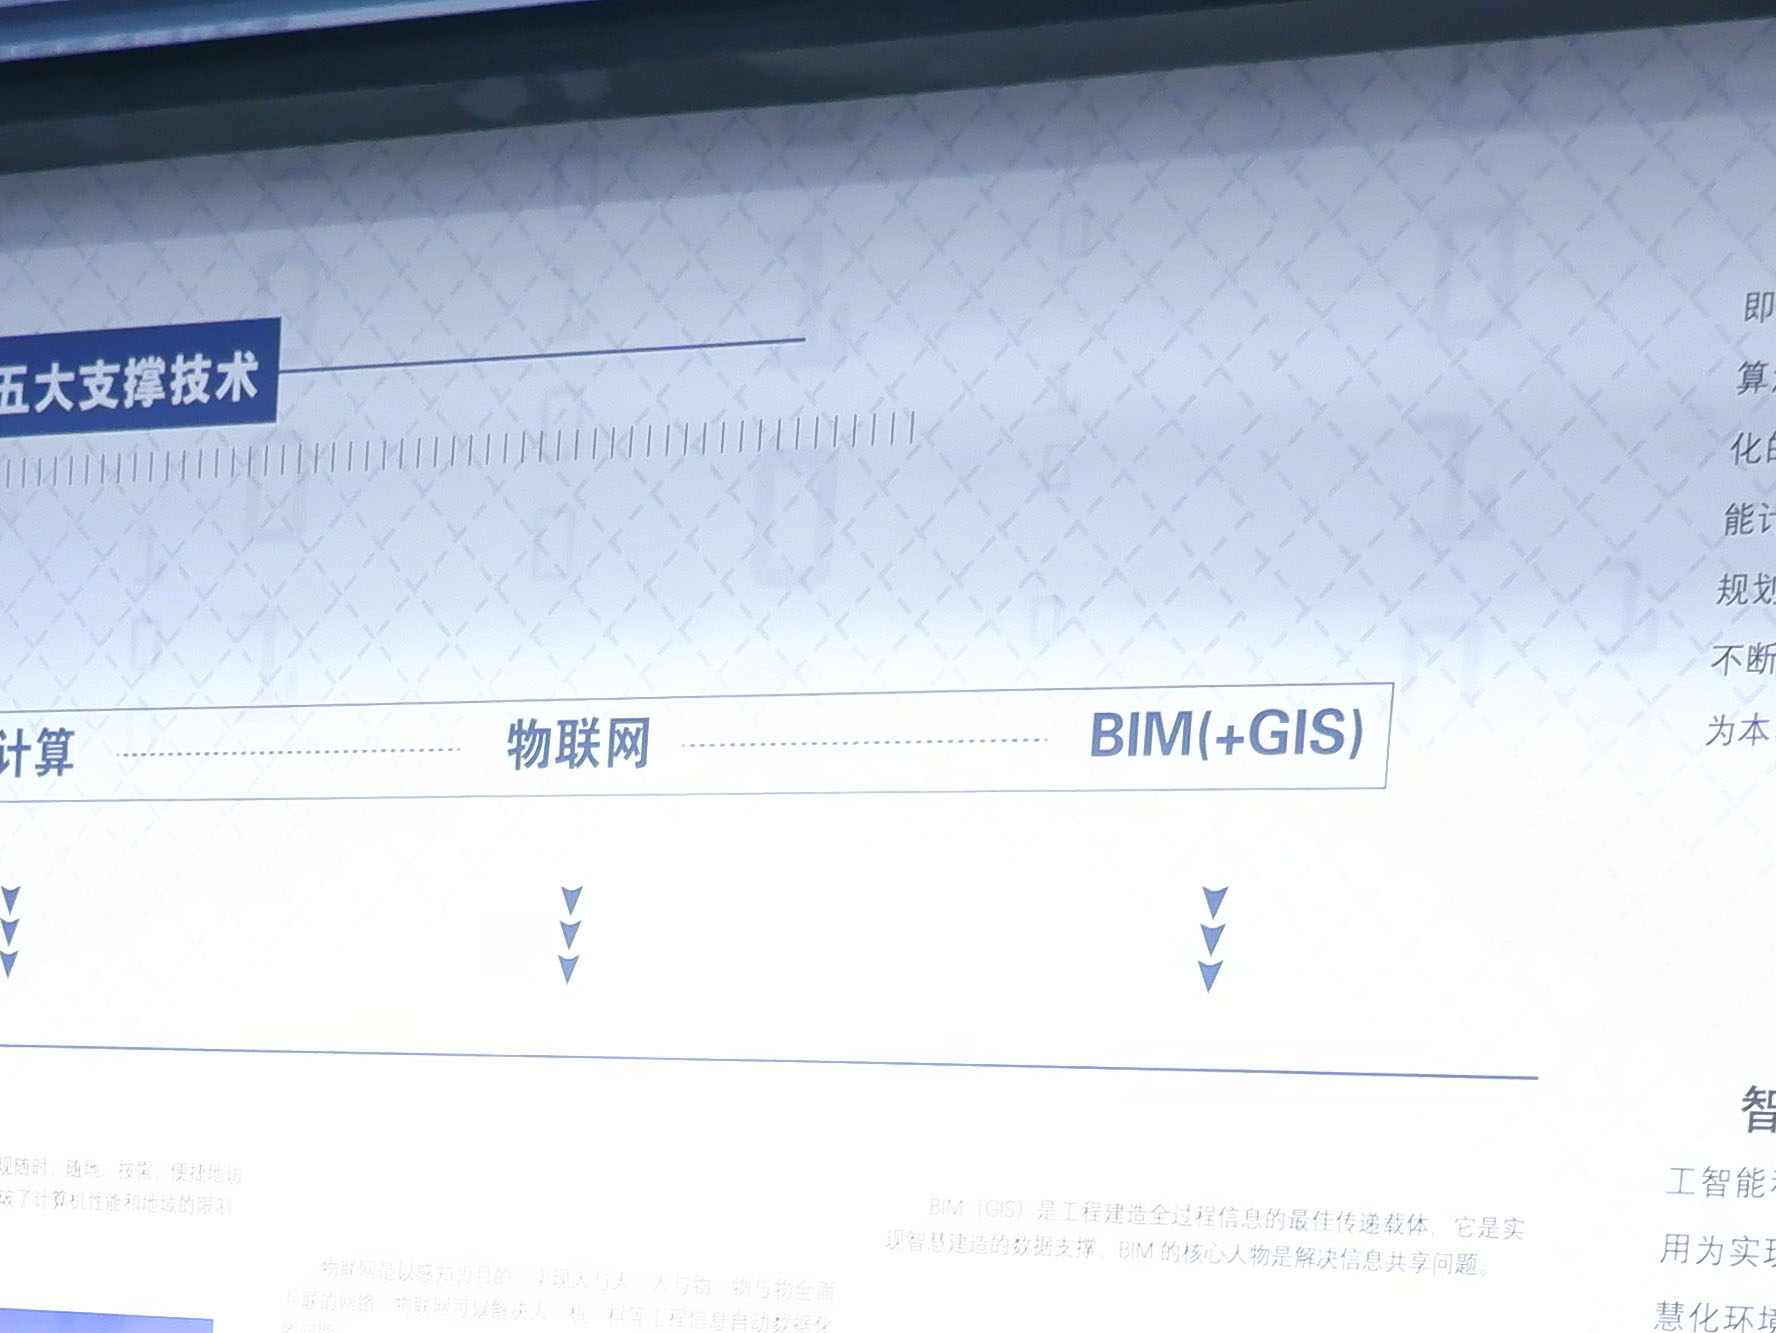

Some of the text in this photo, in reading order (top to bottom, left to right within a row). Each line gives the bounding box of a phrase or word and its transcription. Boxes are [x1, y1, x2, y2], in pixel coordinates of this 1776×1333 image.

[506, 715, 652, 772] 物联网
[1088, 706, 1365, 763] BIM(+GIS)
